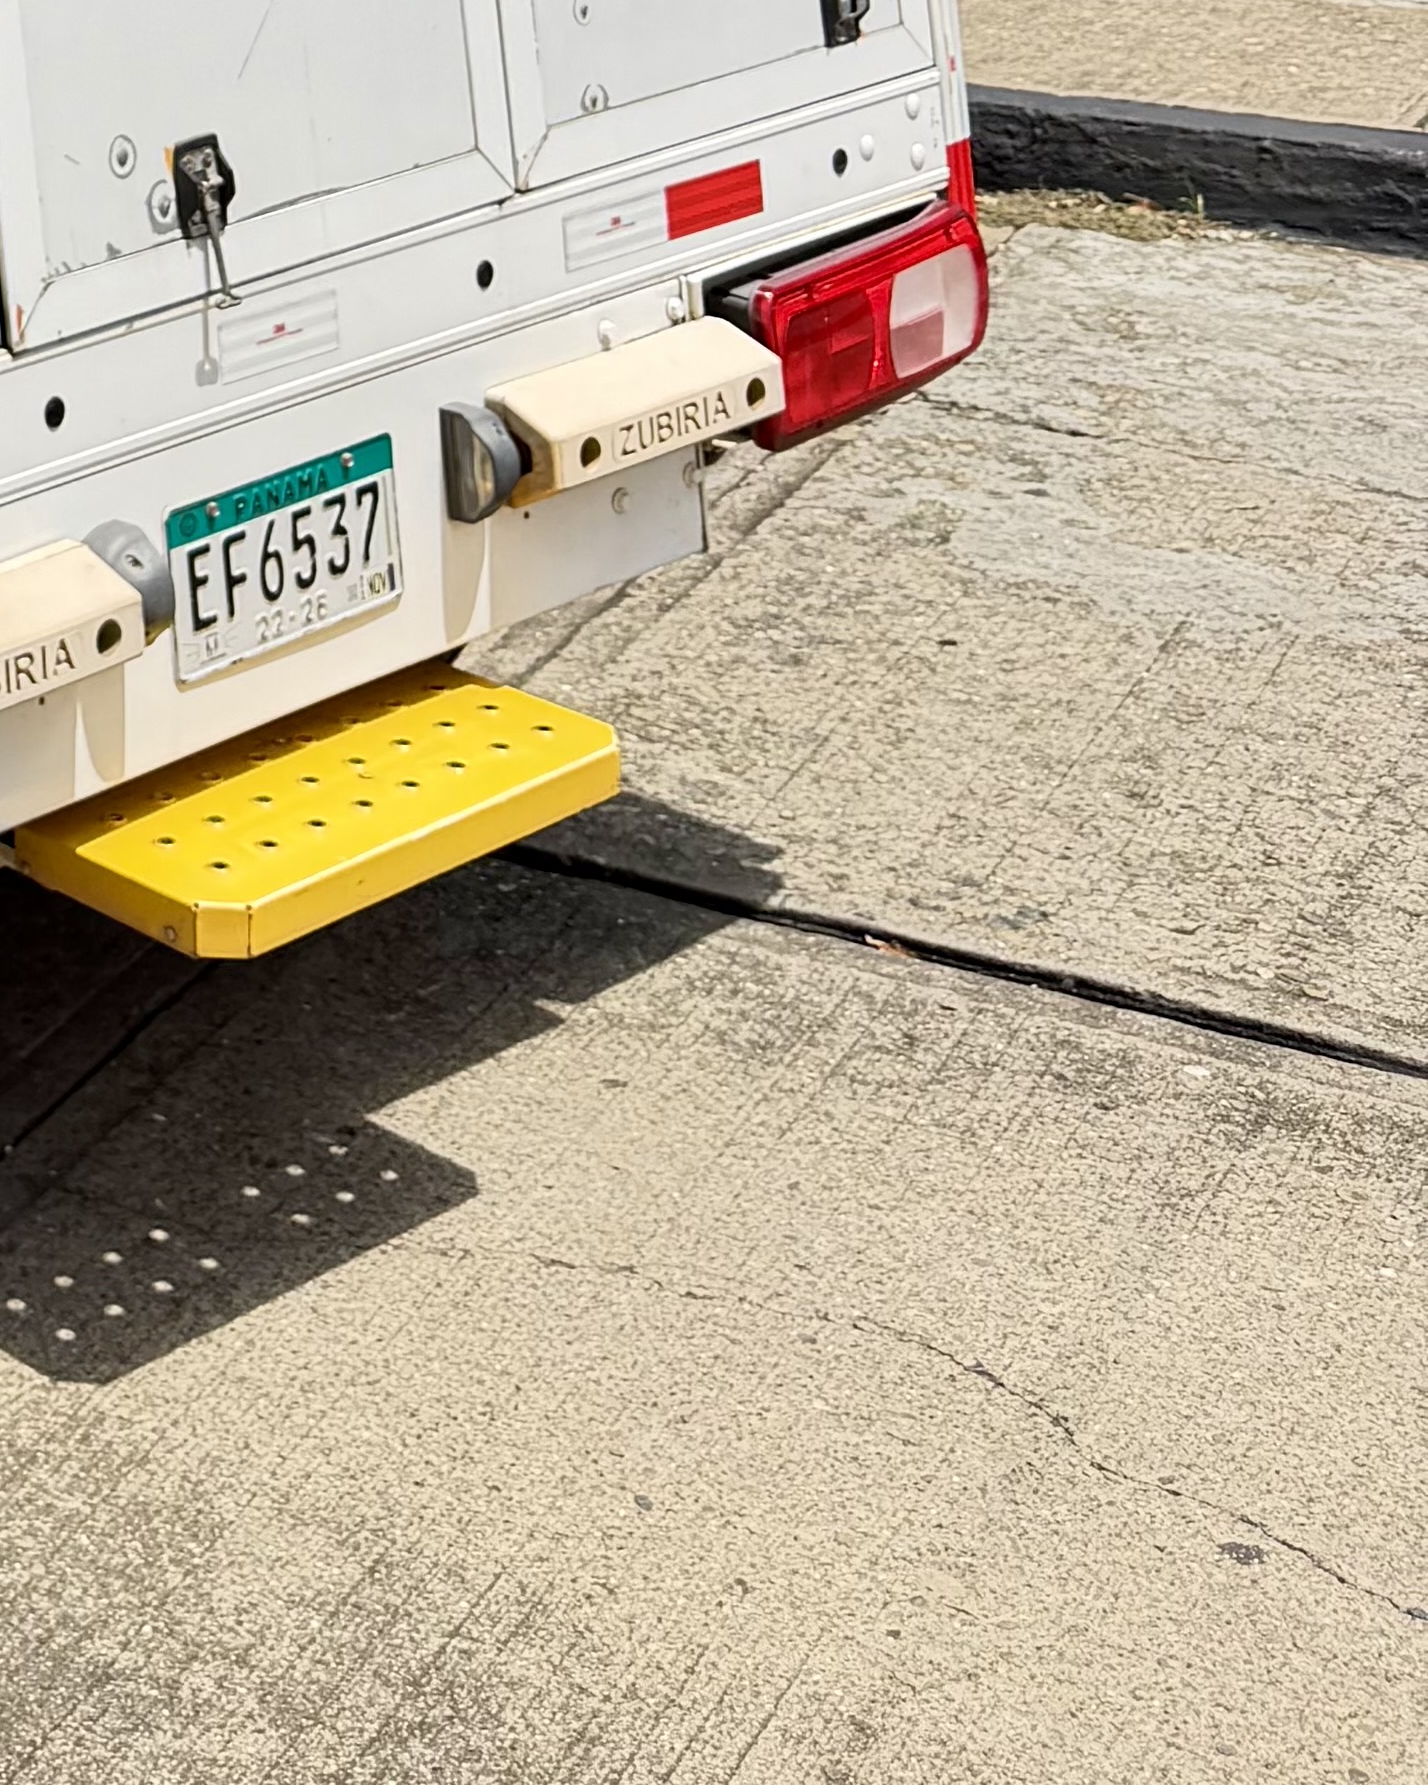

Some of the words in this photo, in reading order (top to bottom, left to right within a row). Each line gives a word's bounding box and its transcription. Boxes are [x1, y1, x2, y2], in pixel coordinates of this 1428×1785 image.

[619, 390, 732, 457] ZUBIRIA
[233, 463, 328, 523] PANAMA
[186, 481, 379, 633] EF6537
